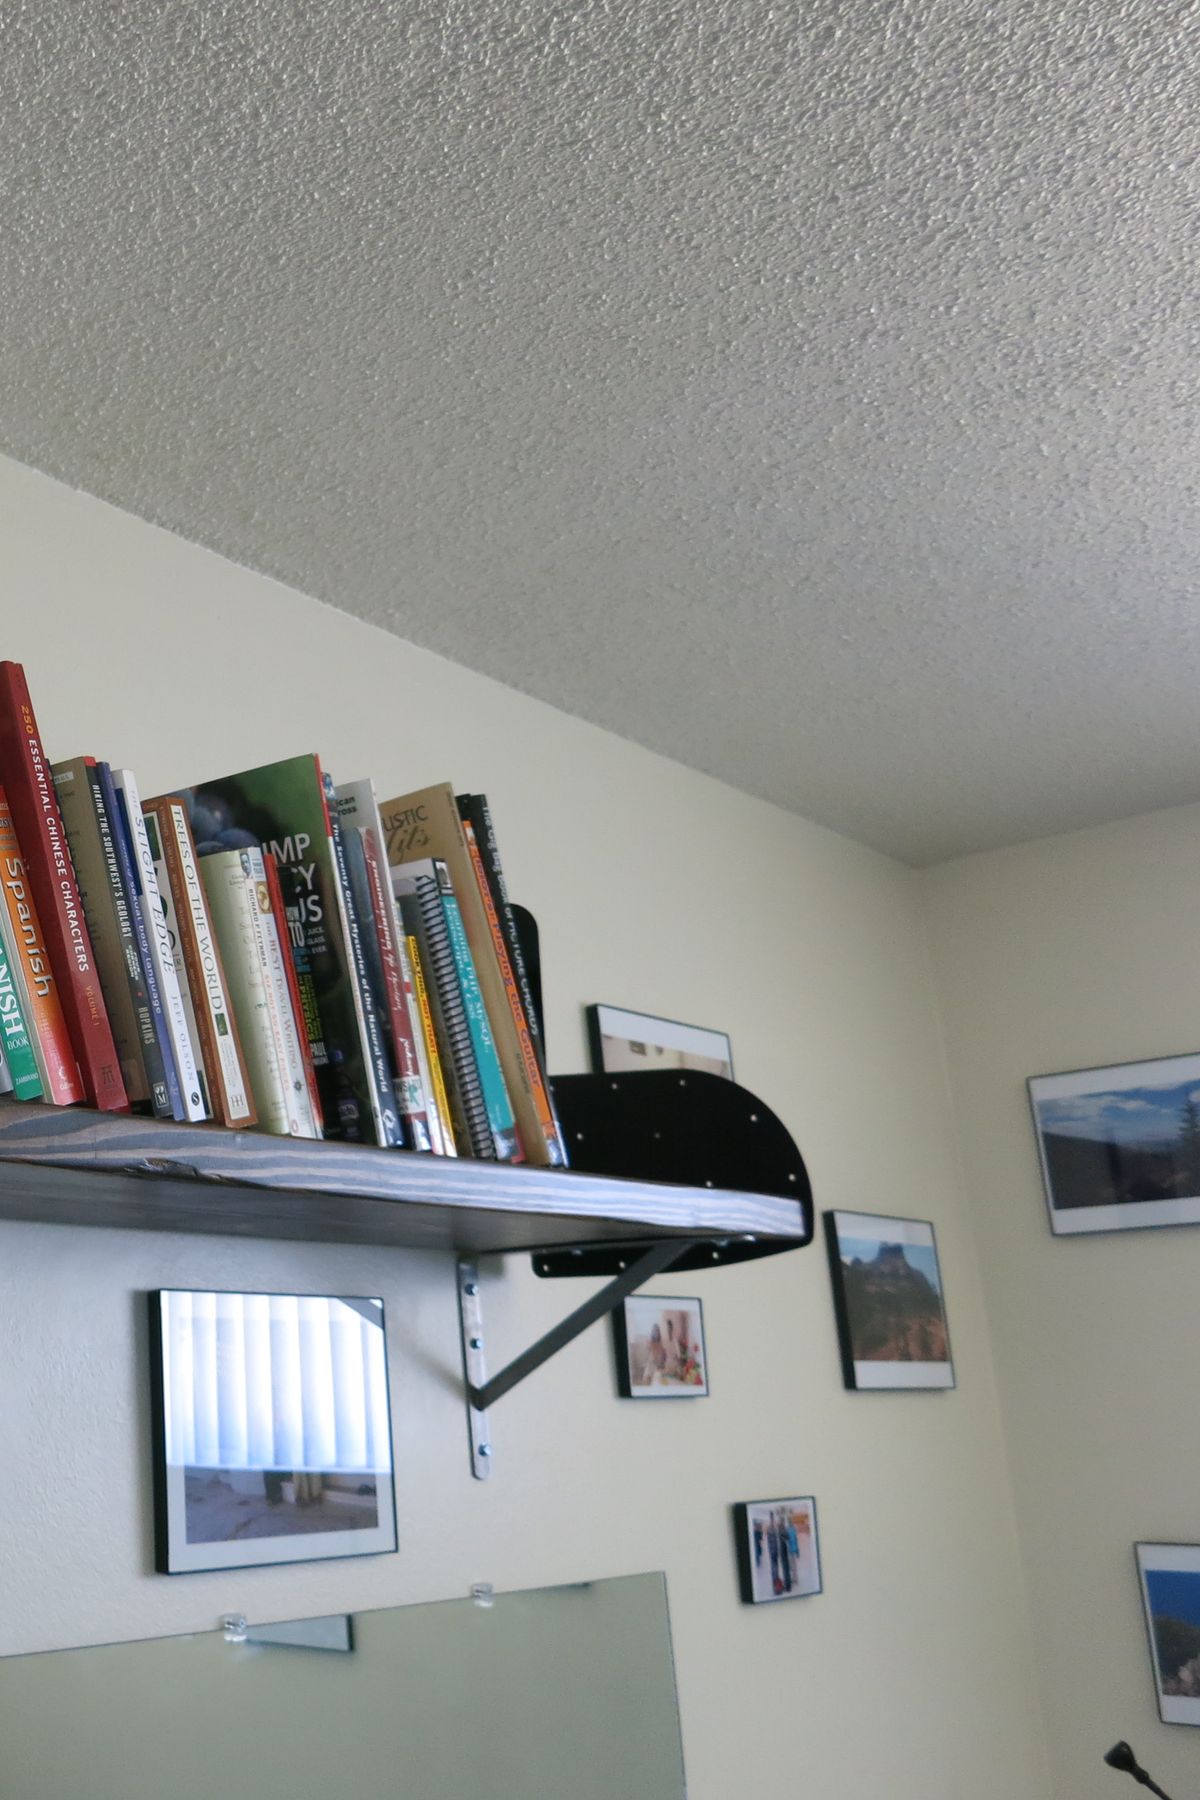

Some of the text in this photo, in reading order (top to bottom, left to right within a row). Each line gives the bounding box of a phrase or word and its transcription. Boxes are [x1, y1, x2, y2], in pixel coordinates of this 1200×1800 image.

[21, 705, 33, 734] 250
[29, 739, 52, 812] ESSENTIAL
[46, 817, 67, 876] CHINESE
[60, 881, 89, 972] CHARACTERS
[86, 985, 98, 1020] VOLUME
[92, 784, 132, 937] HIKING THE SOUTHWEST'S GEOLOGY
[336, 845, 348, 887] Seventy
[135, 817, 158, 896] SLIGHT
[152, 907, 174, 974] EDGE
[172, 809, 224, 1010] TREES OF THE WORLD
[346, 890, 355, 919] Great
[6, 857, 54, 998] Spanish
[129, 881, 143, 920] sexual
[138, 925, 150, 955] body
[145, 957, 161, 1014] language
[249, 888, 259, 922] RICHARD
[257, 928, 267, 967] FEYNMAN
[351, 923, 365, 976] Mysteries
[361, 977, 370, 990] of
[363, 990, 372, 1010] the
[7, 1036, 30, 1050] BOOK
[138, 1007, 155, 1045] HOPKINS
[368, 1014, 381, 1056] Natural
[510, 993, 523, 1021] the
[519, 1029, 540, 1087] Guitar
[180, 1033, 195, 1081] OLSON
[377, 1058, 389, 1092] World
